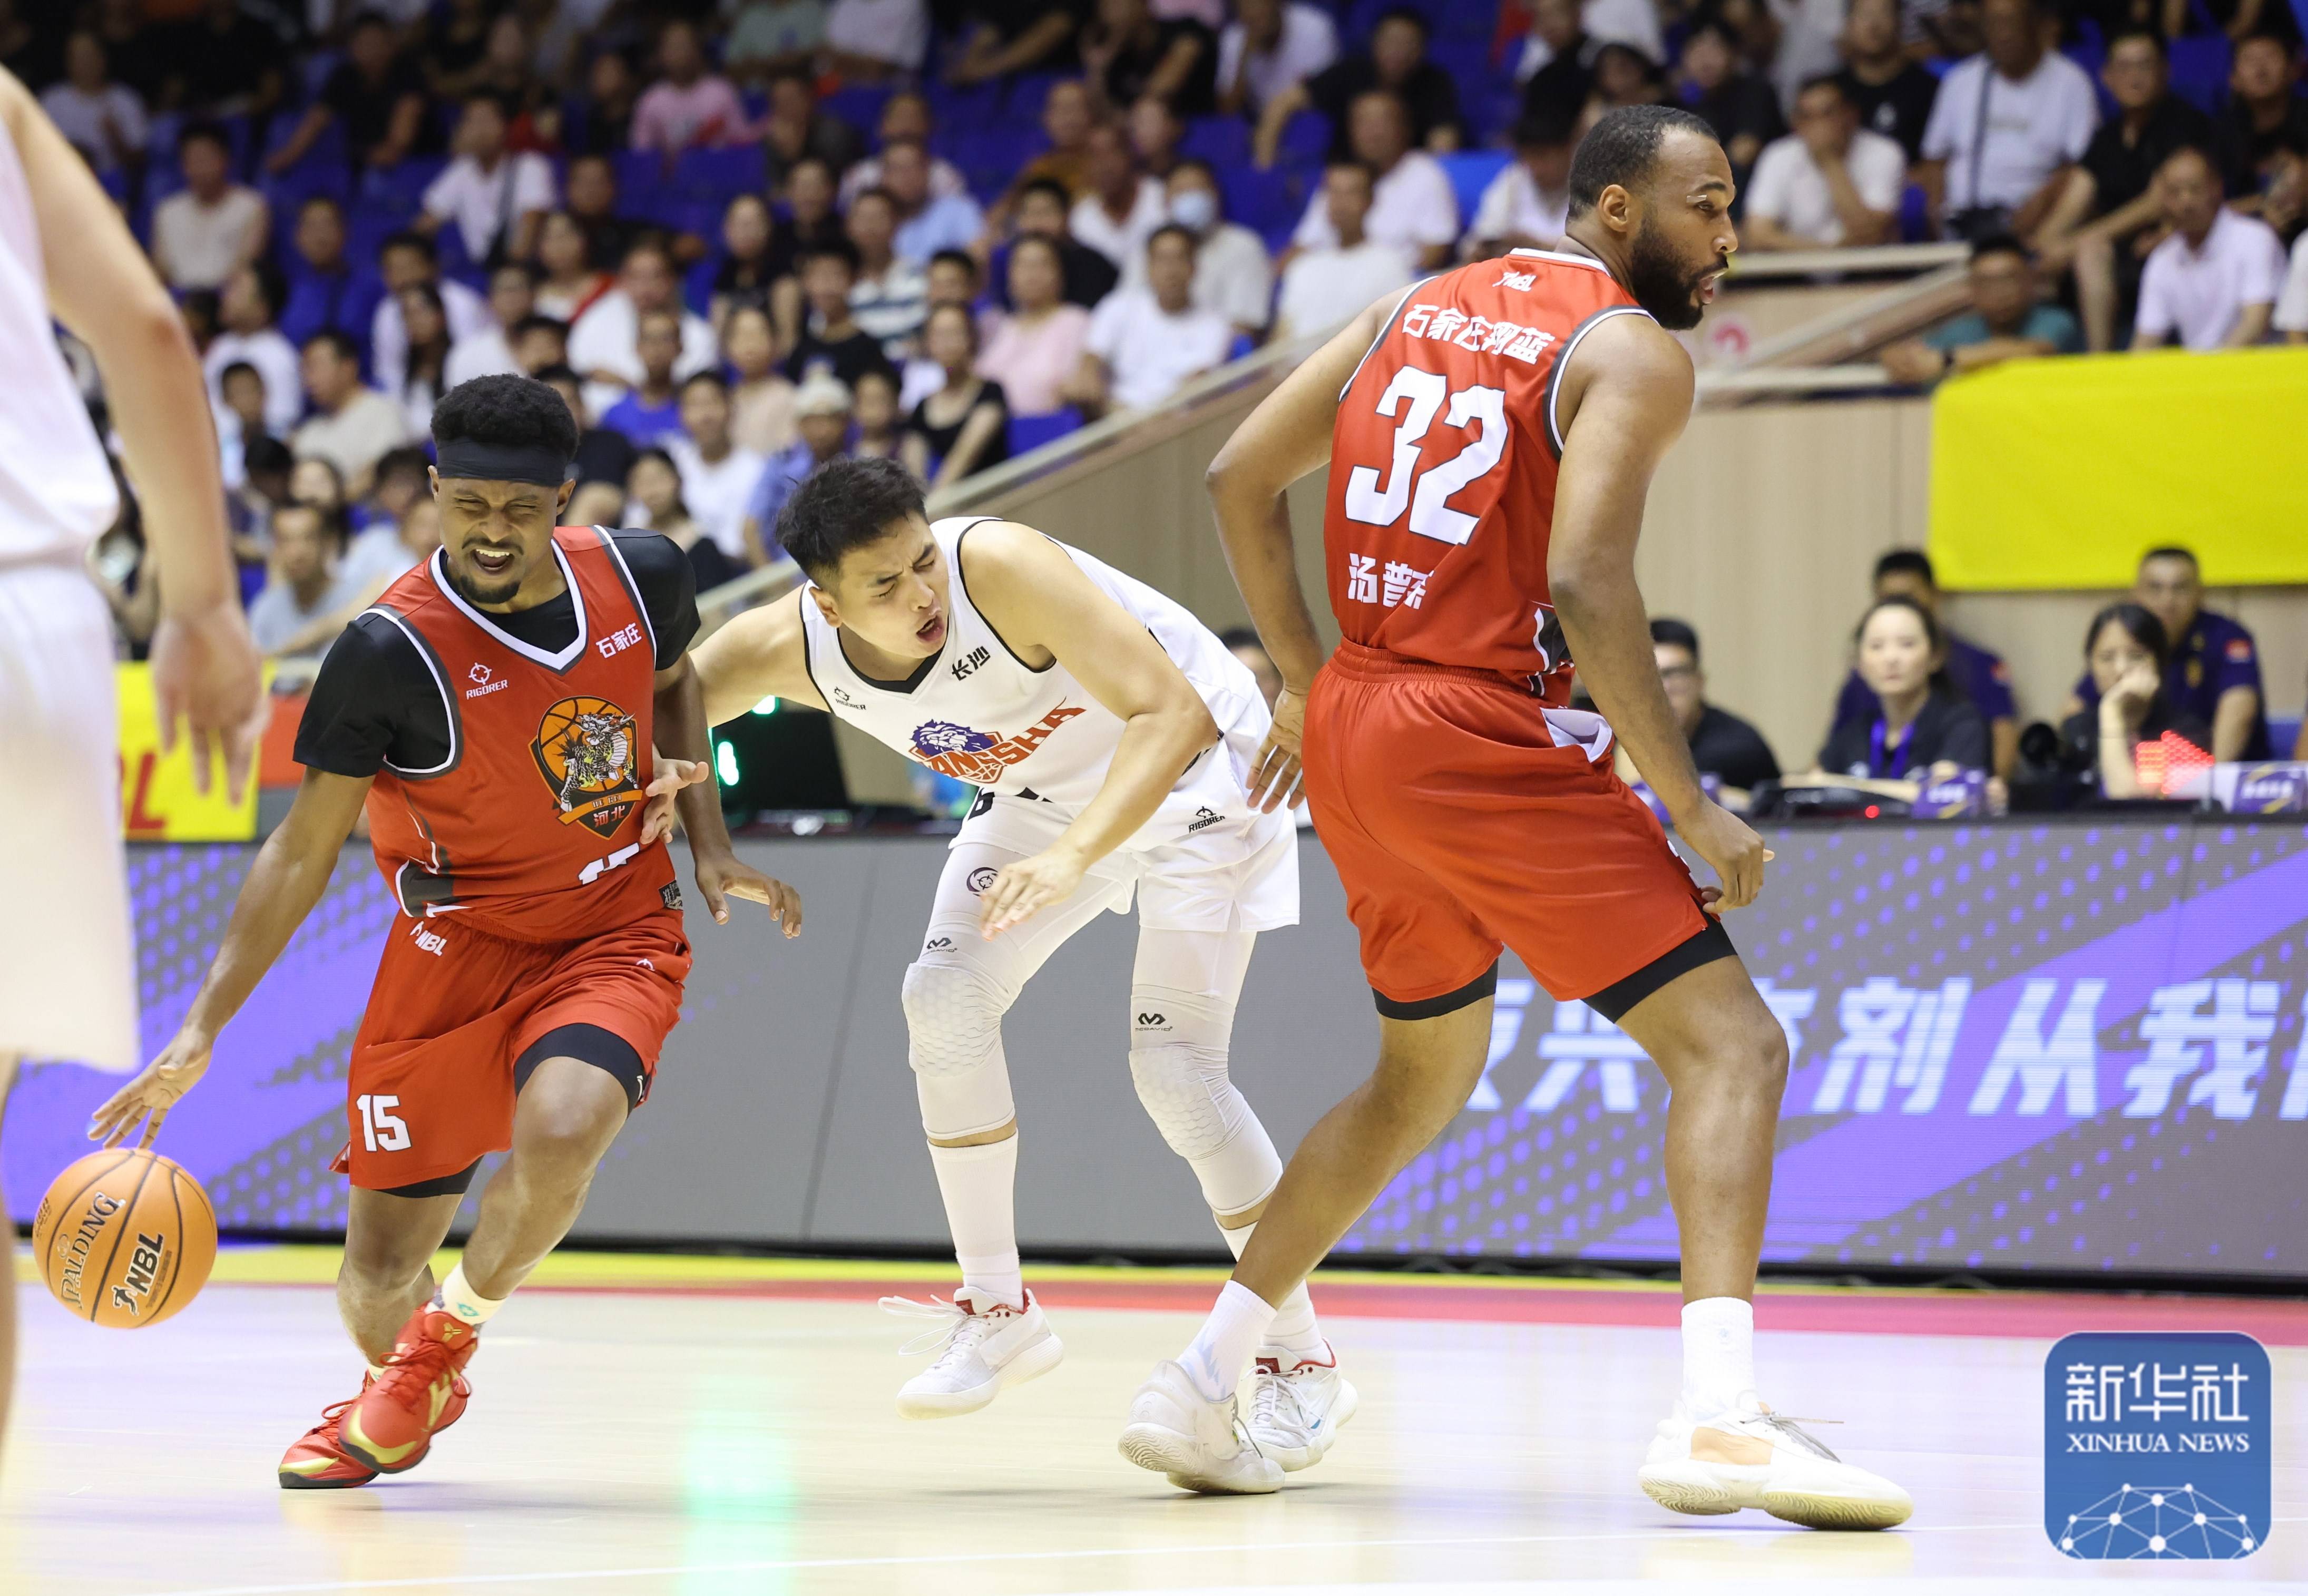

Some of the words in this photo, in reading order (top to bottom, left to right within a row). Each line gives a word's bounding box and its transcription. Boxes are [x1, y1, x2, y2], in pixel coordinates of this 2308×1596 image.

[1345, 365, 1509, 546] 32
[595, 622, 642, 658] 石家庄
[951, 645, 991, 681] 长沙
[466, 679, 508, 700] RIGORER
[593, 805, 625, 827] 河北
[414, 929, 447, 956] NBL
[356, 1093, 412, 1152] 15
[124, 1233, 164, 1297] NBL
